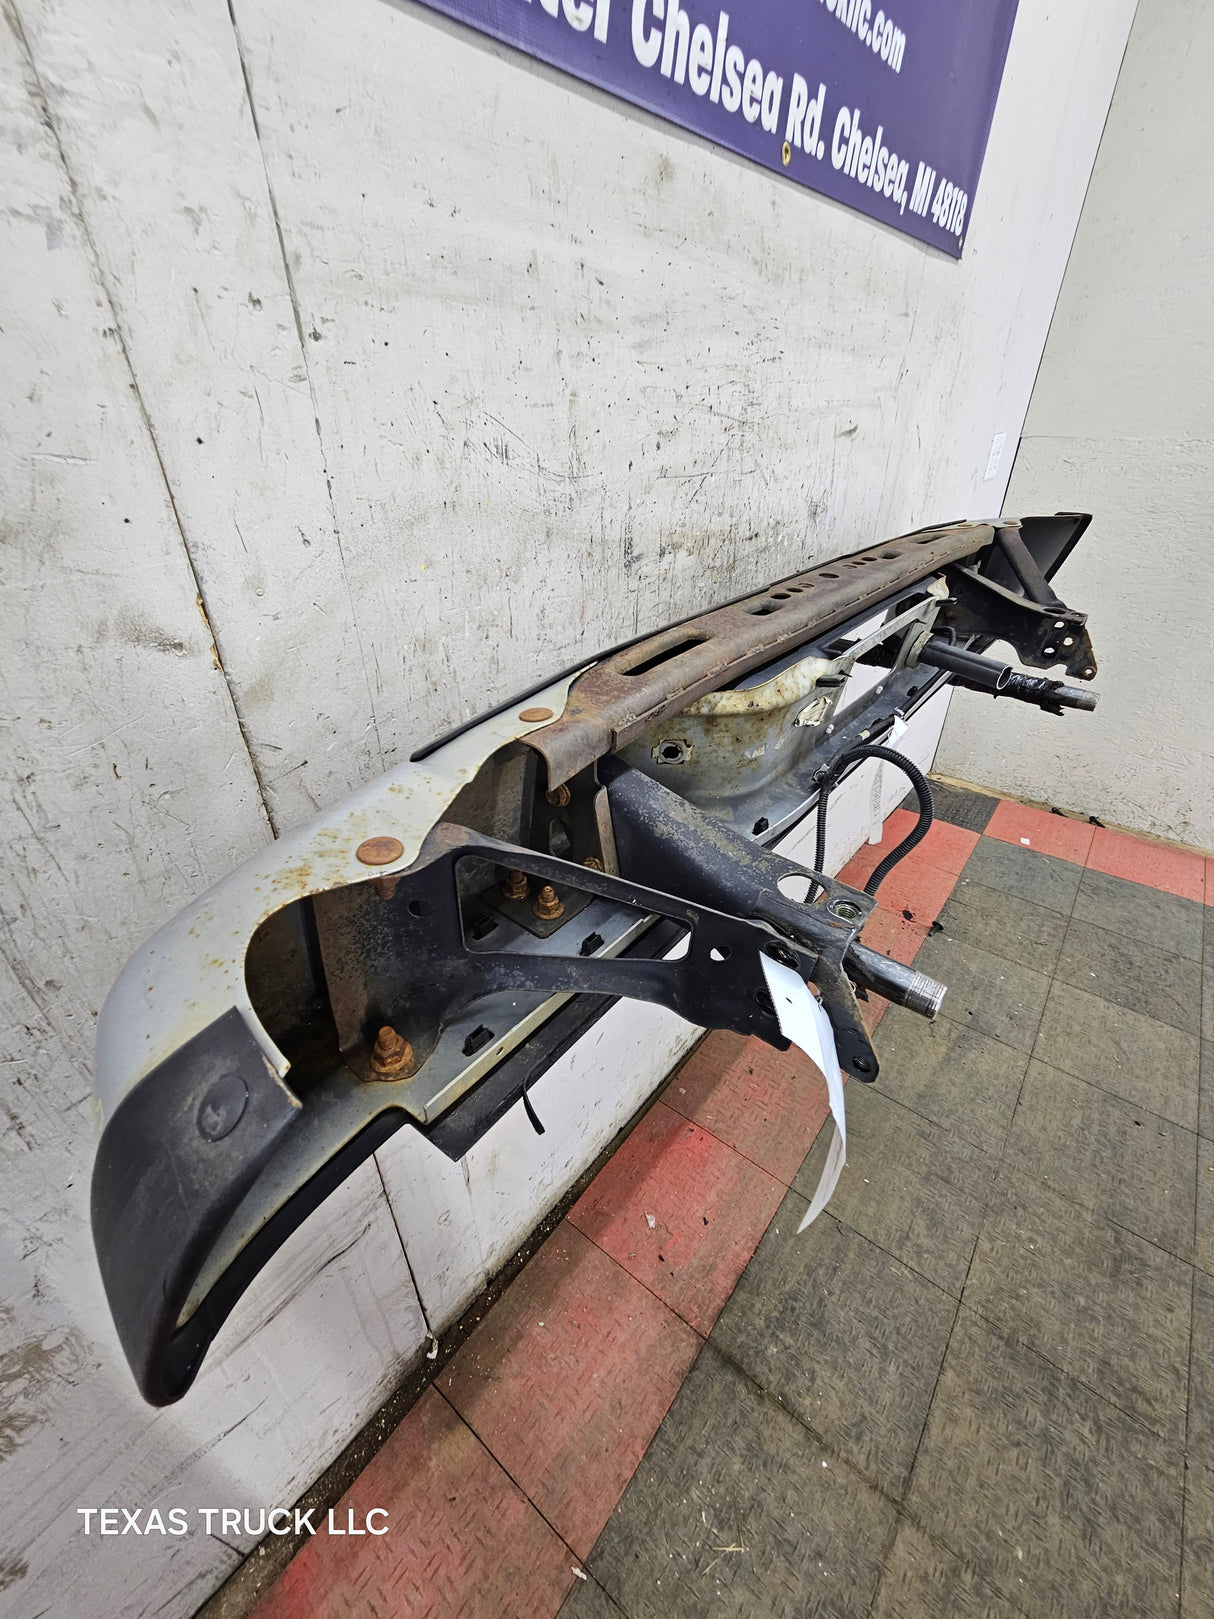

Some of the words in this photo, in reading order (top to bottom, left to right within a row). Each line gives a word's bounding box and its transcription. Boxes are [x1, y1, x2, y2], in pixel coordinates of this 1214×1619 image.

[631, 0, 784, 135] Chelsea
[784, 72, 827, 160] Rd.
[831, 106, 909, 216] Chelsea,
[908, 161, 936, 217] MI
[931, 177, 968, 236] 48118
